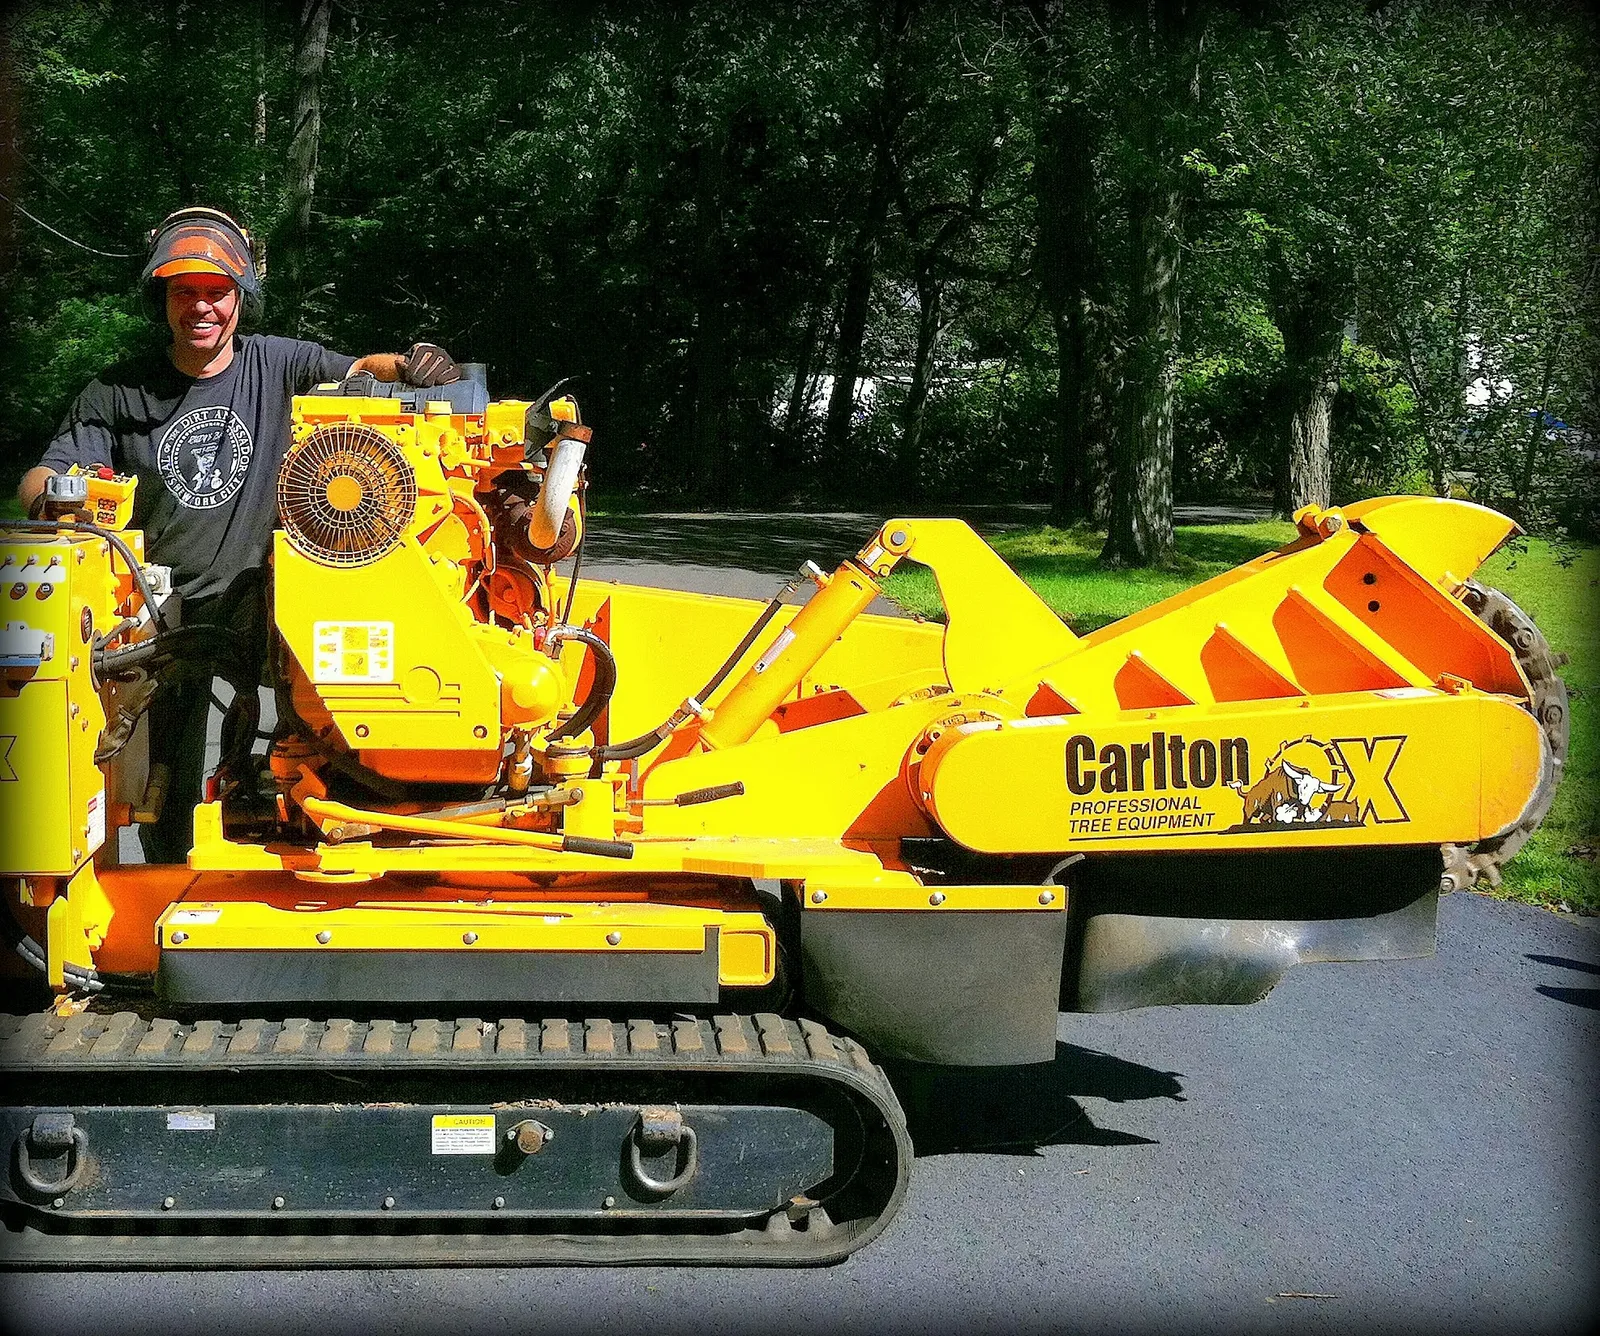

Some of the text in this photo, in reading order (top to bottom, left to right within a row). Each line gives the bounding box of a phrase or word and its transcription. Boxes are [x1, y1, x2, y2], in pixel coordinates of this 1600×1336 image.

[180, 411, 209, 429] DIRT
[214, 409, 250, 475] AASSADOR
[173, 482, 192, 502] NEW
[220, 477, 241, 499] CITY
[1066, 732, 1249, 796] Carlton
[1070, 796, 1201, 815] PROFESSIONAL
[1070, 813, 1215, 833] TREE EQUIPMENT
